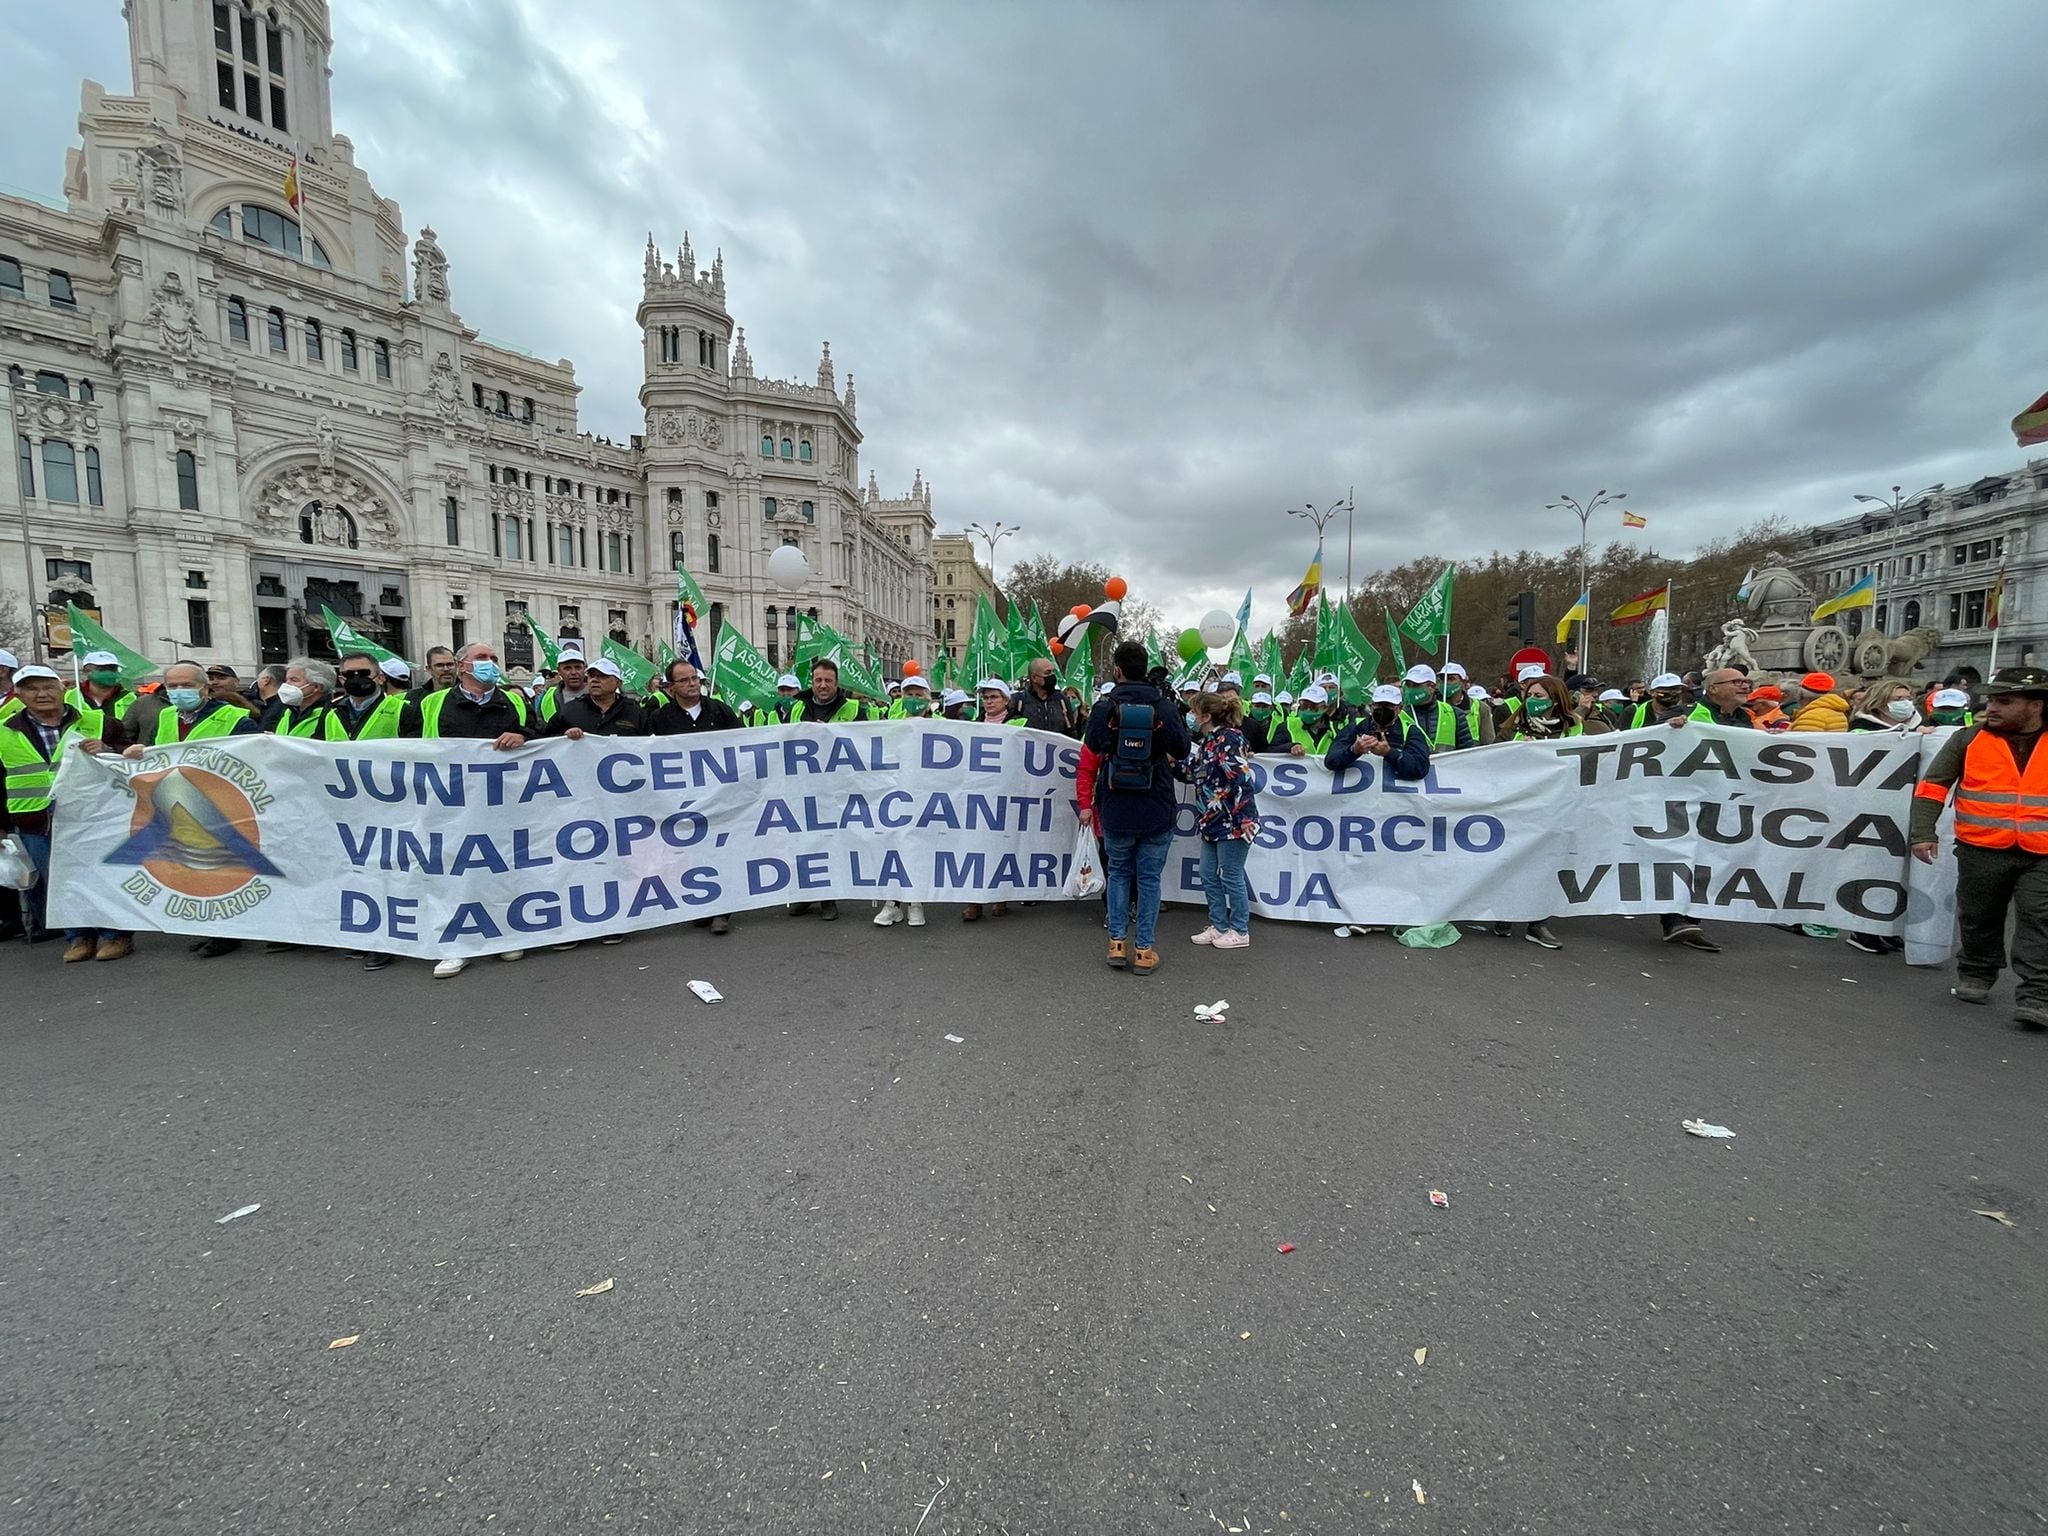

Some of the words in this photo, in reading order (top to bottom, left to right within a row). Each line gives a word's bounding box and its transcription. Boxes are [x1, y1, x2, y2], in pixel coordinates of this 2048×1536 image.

[735, 649, 778, 683] ASAJA
[325, 758, 573, 807] JUNTA
[596, 735, 900, 794] CENTRAL
[921, 732, 1003, 774] DE
[1124, 739, 1145, 748] LiveU
[177, 746, 275, 814] CENTRAL
[336, 801, 731, 876] VINALOPÓ,
[754, 788, 1057, 837] ALACANTÍ
[121, 870, 161, 906] DE
[164, 878, 272, 922] USUARIOS
[340, 889, 419, 941] DE
[438, 865, 723, 942] AGUAS
[746, 852, 831, 896] DE
[850, 849, 913, 888] LA
[934, 850, 1072, 890] MARI
